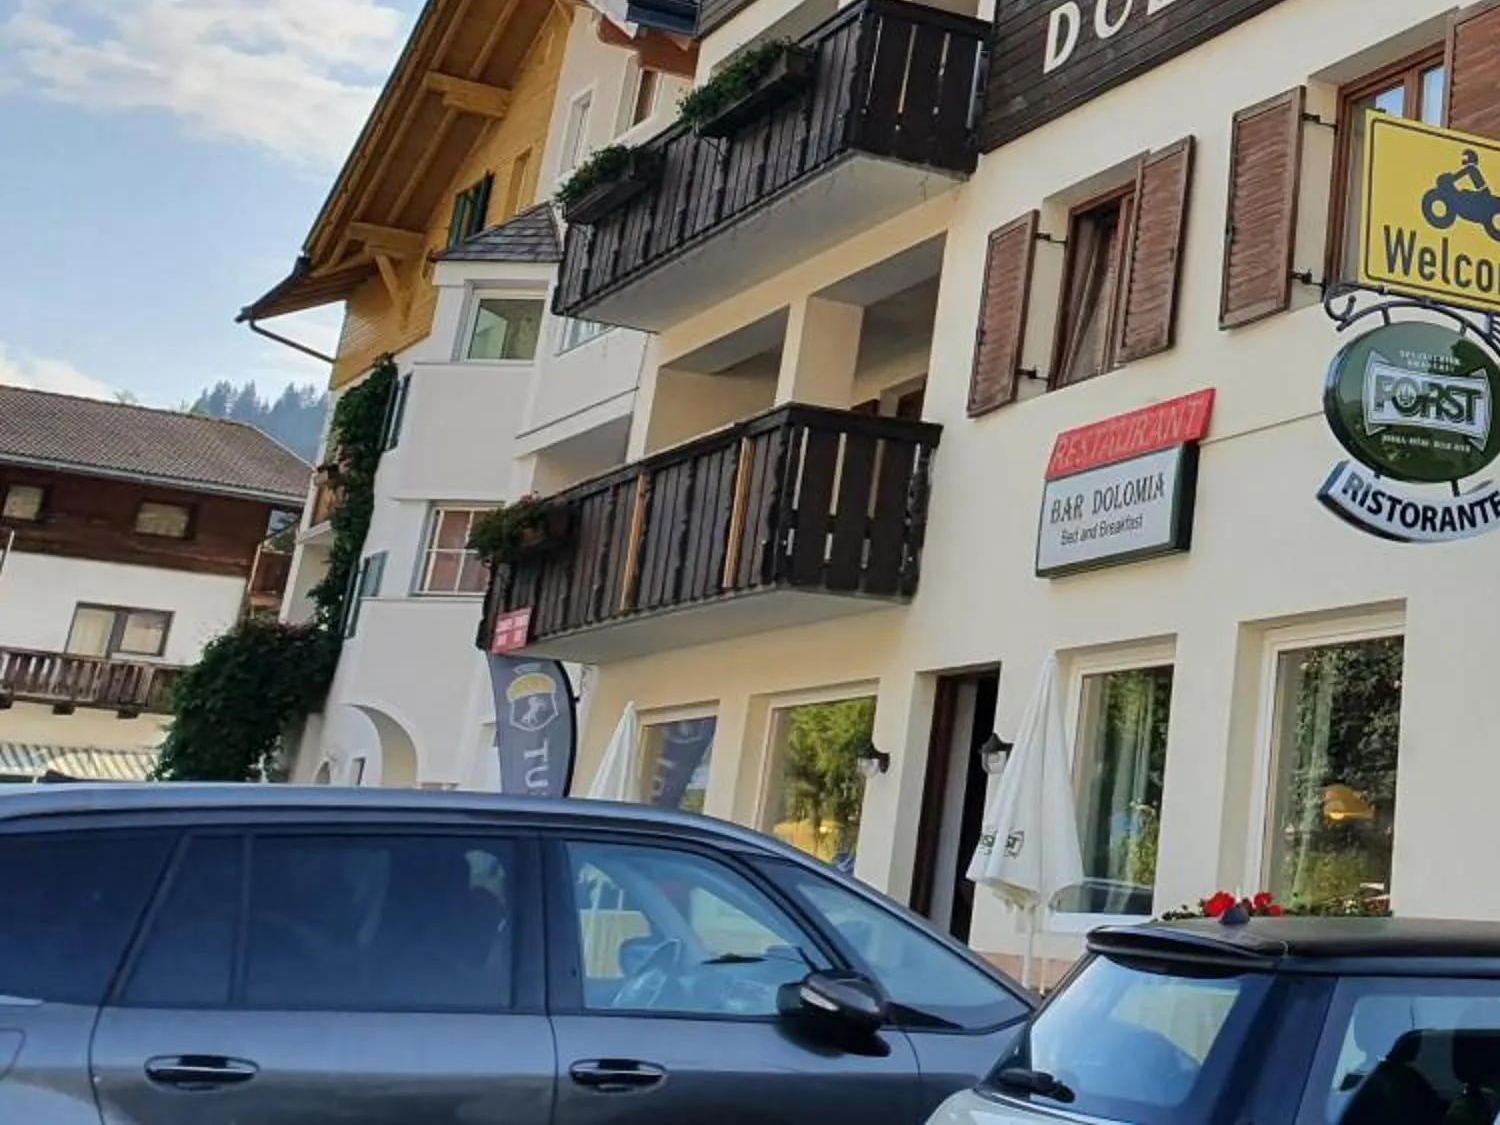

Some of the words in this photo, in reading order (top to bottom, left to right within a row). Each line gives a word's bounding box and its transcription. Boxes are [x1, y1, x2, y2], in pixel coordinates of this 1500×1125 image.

[1375, 375, 1483, 426] FORST
[1052, 400, 1202, 466] RESTAURANT
[1049, 493, 1085, 524] BAR
[1091, 472, 1165, 516] DOLOMIA
[1060, 528, 1079, 546] Bed
[1079, 522, 1099, 542] and
[1099, 513, 1144, 538] Breakfast
[523, 739, 549, 794] TU
